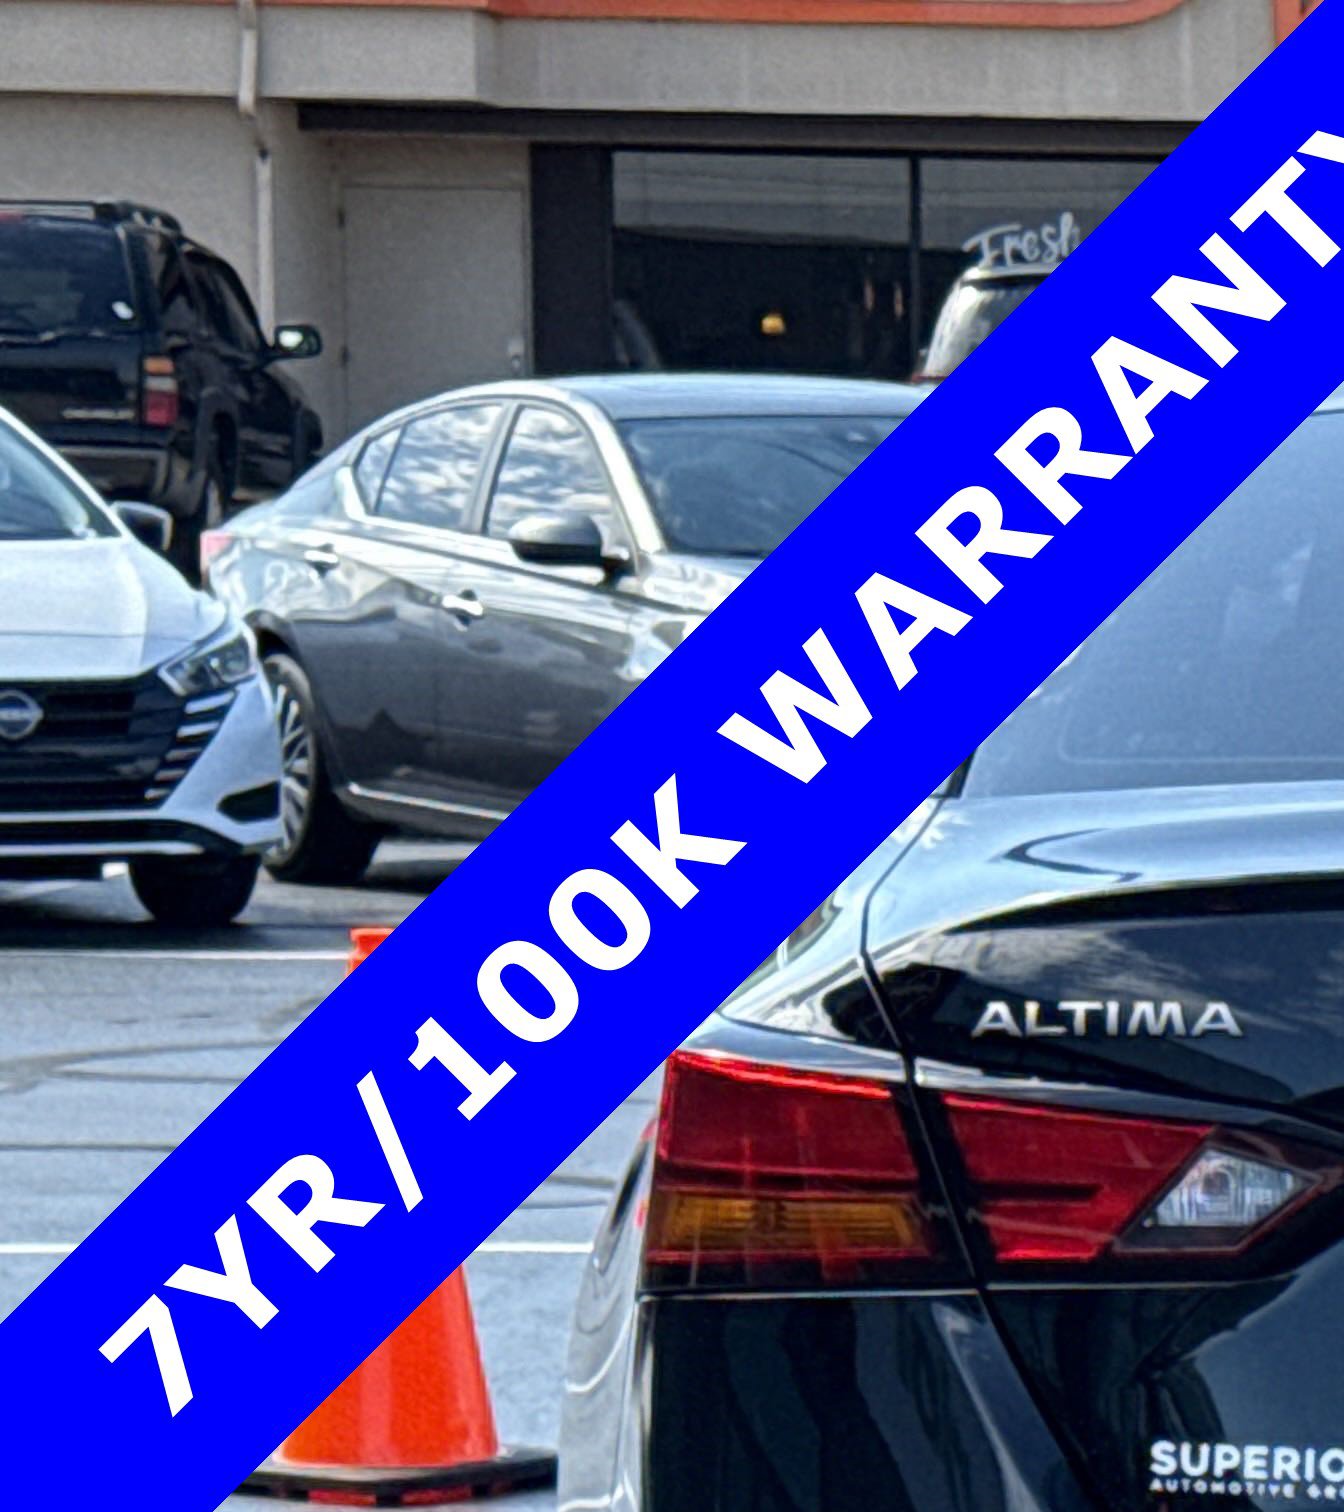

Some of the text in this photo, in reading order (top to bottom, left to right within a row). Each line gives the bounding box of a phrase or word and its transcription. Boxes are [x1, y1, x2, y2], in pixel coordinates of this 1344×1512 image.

[961, 211, 1083, 270] Fresh
[970, 1000, 1244, 1038] ALTIMA
[1150, 1477, 1296, 1499] AUTOMOTIVE
